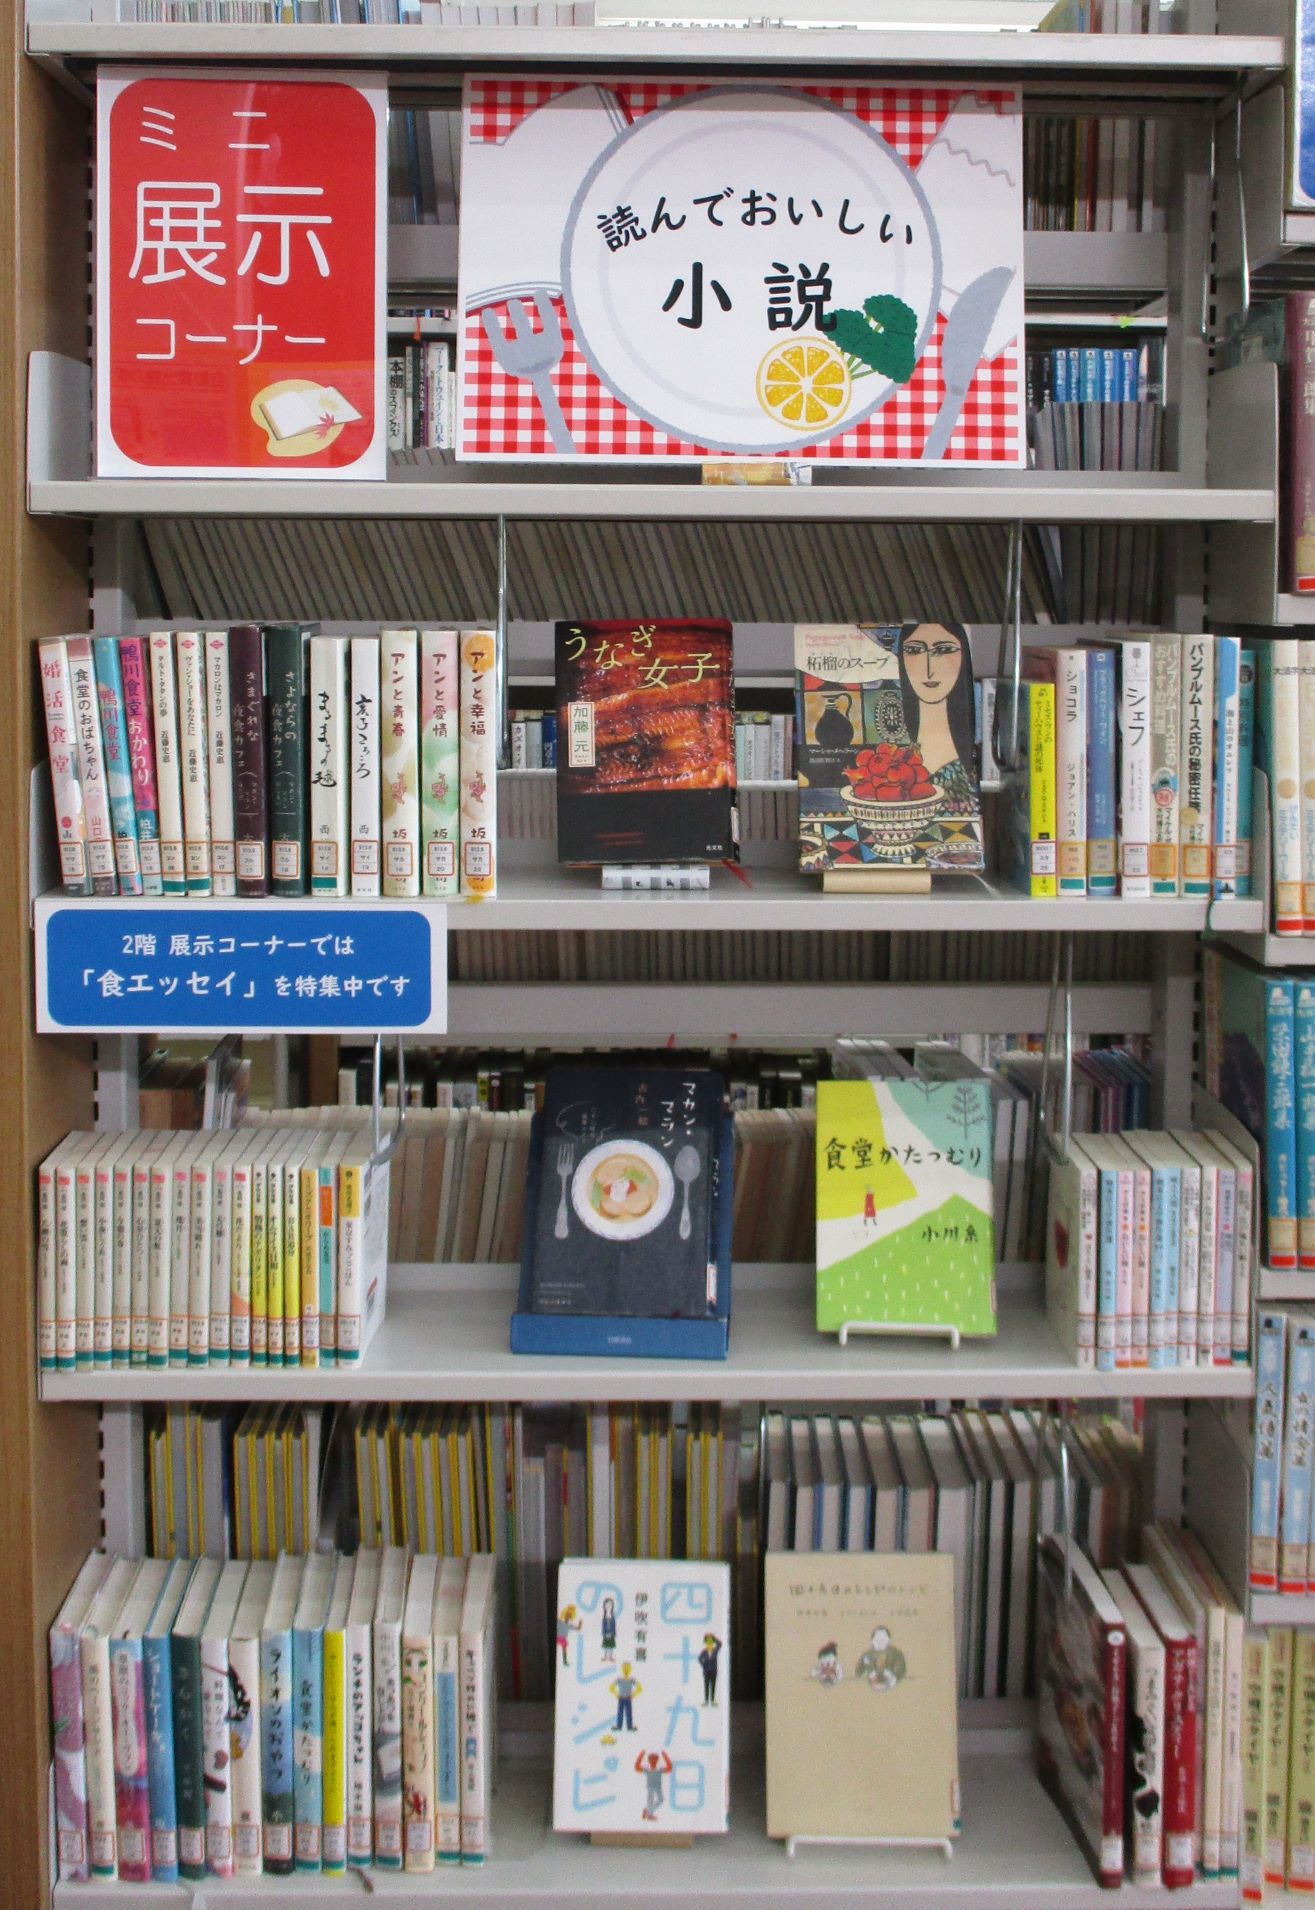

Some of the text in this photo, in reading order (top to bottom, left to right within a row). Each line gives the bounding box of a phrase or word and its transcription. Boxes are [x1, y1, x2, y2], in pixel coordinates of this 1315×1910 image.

[140, 106, 270, 151] ミニ
[128, 181, 332, 285] 展示
[597, 187, 913, 253] 読んでおいしい
[662, 261, 837, 332] 小説
[136, 314, 326, 365] コーナー
[565, 624, 720, 690] うなぎ女子
[807, 655, 889, 672] 柘榴のスープ
[43, 659, 69, 774] 婚活食堂
[74, 668, 99, 781] 食堂のおばちゃん
[100, 687, 121, 762] 鴨川食堂
[390, 652, 406, 738] アンと青春
[432, 653, 448, 738] アンと愛情
[470, 651, 486, 736] アンと幸福
[1065, 671, 1078, 723] ショコラ
[1126, 687, 1146, 747] シェフ
[121, 933, 355, 956] 2階 展示コーナーでは
[660, 1100, 675, 1148] マラン
[823, 1136, 982, 1171] 食堂かたつむり
[921, 1225, 979, 1244] 小川糸
[572, 1580, 625, 1813] のレシピ
[660, 1581, 717, 1813] 四十九日
